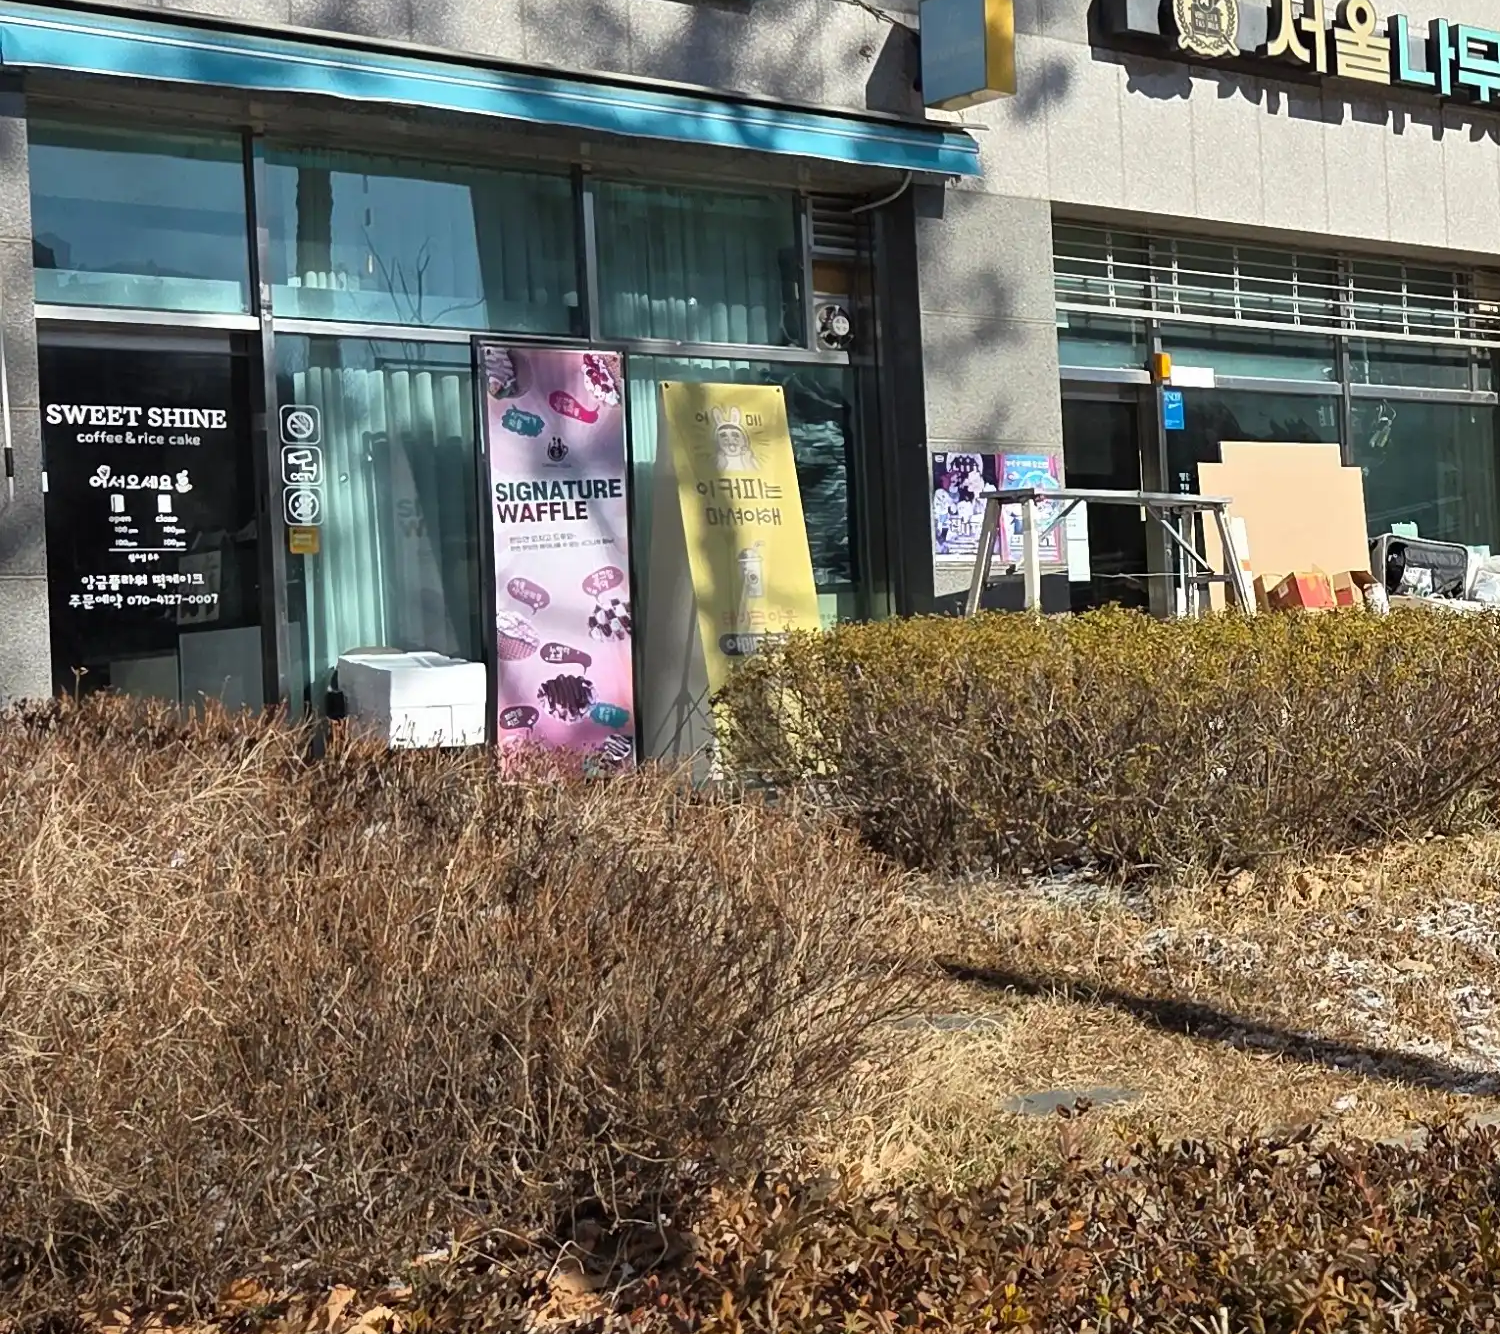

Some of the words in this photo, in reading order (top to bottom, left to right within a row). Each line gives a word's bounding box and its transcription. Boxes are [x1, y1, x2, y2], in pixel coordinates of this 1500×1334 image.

[46, 403, 142, 427] SWEET
[147, 406, 227, 429] SHINE
[168, 433, 201, 446] cake
[89, 474, 173, 491] 어서오세요
[290, 471, 316, 482] CCTV
[495, 479, 623, 502] SIGNATURE
[496, 501, 588, 524] WAFFLE
[68, 593, 124, 610] 주문예약
[126, 593, 219, 606] 070-4127-0007
